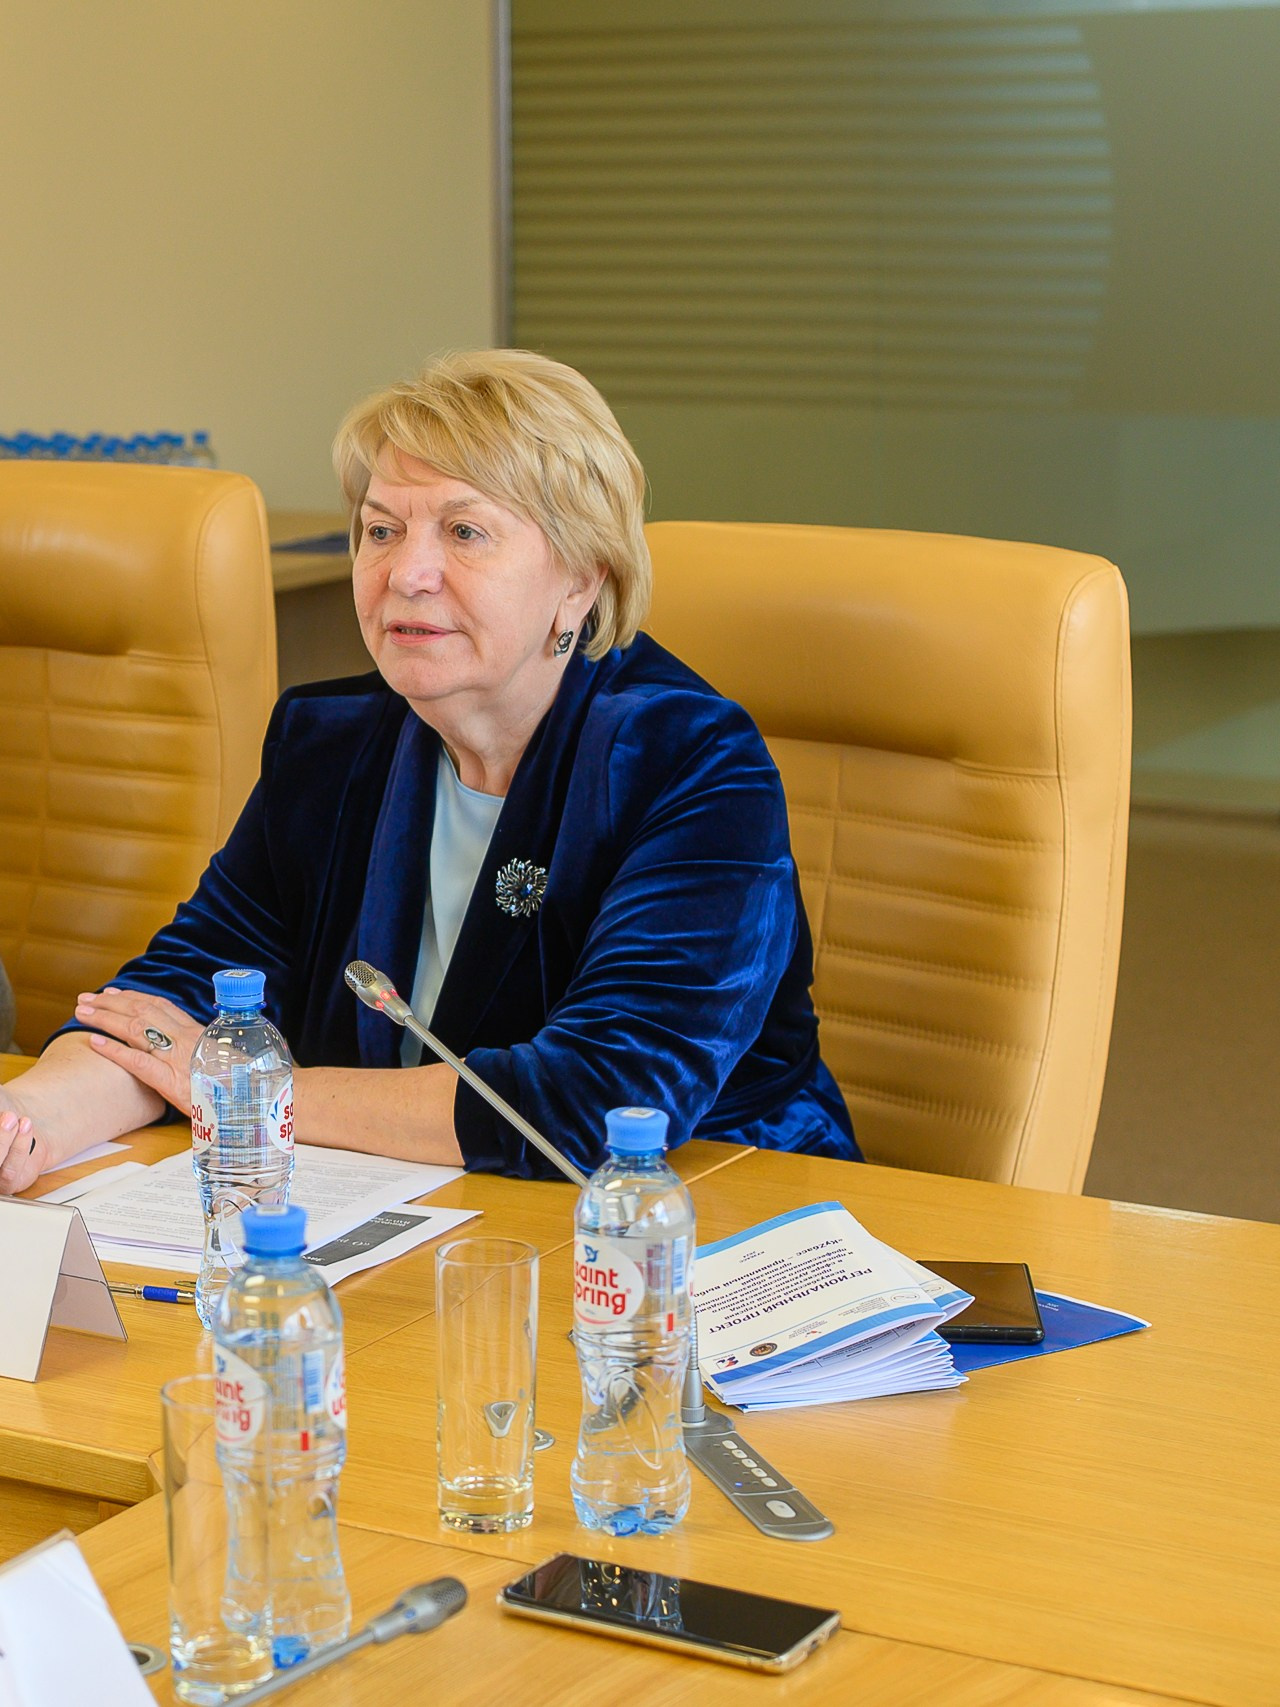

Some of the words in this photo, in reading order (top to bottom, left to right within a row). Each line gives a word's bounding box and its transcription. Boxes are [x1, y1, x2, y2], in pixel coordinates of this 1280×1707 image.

[575, 1280, 626, 1316] pring
[694, 1286, 720, 1298] выбо
[762, 1268, 872, 1314] РЕГИОНАЛЬНЫЙ
[709, 1311, 760, 1334] ПРОЕКТ
